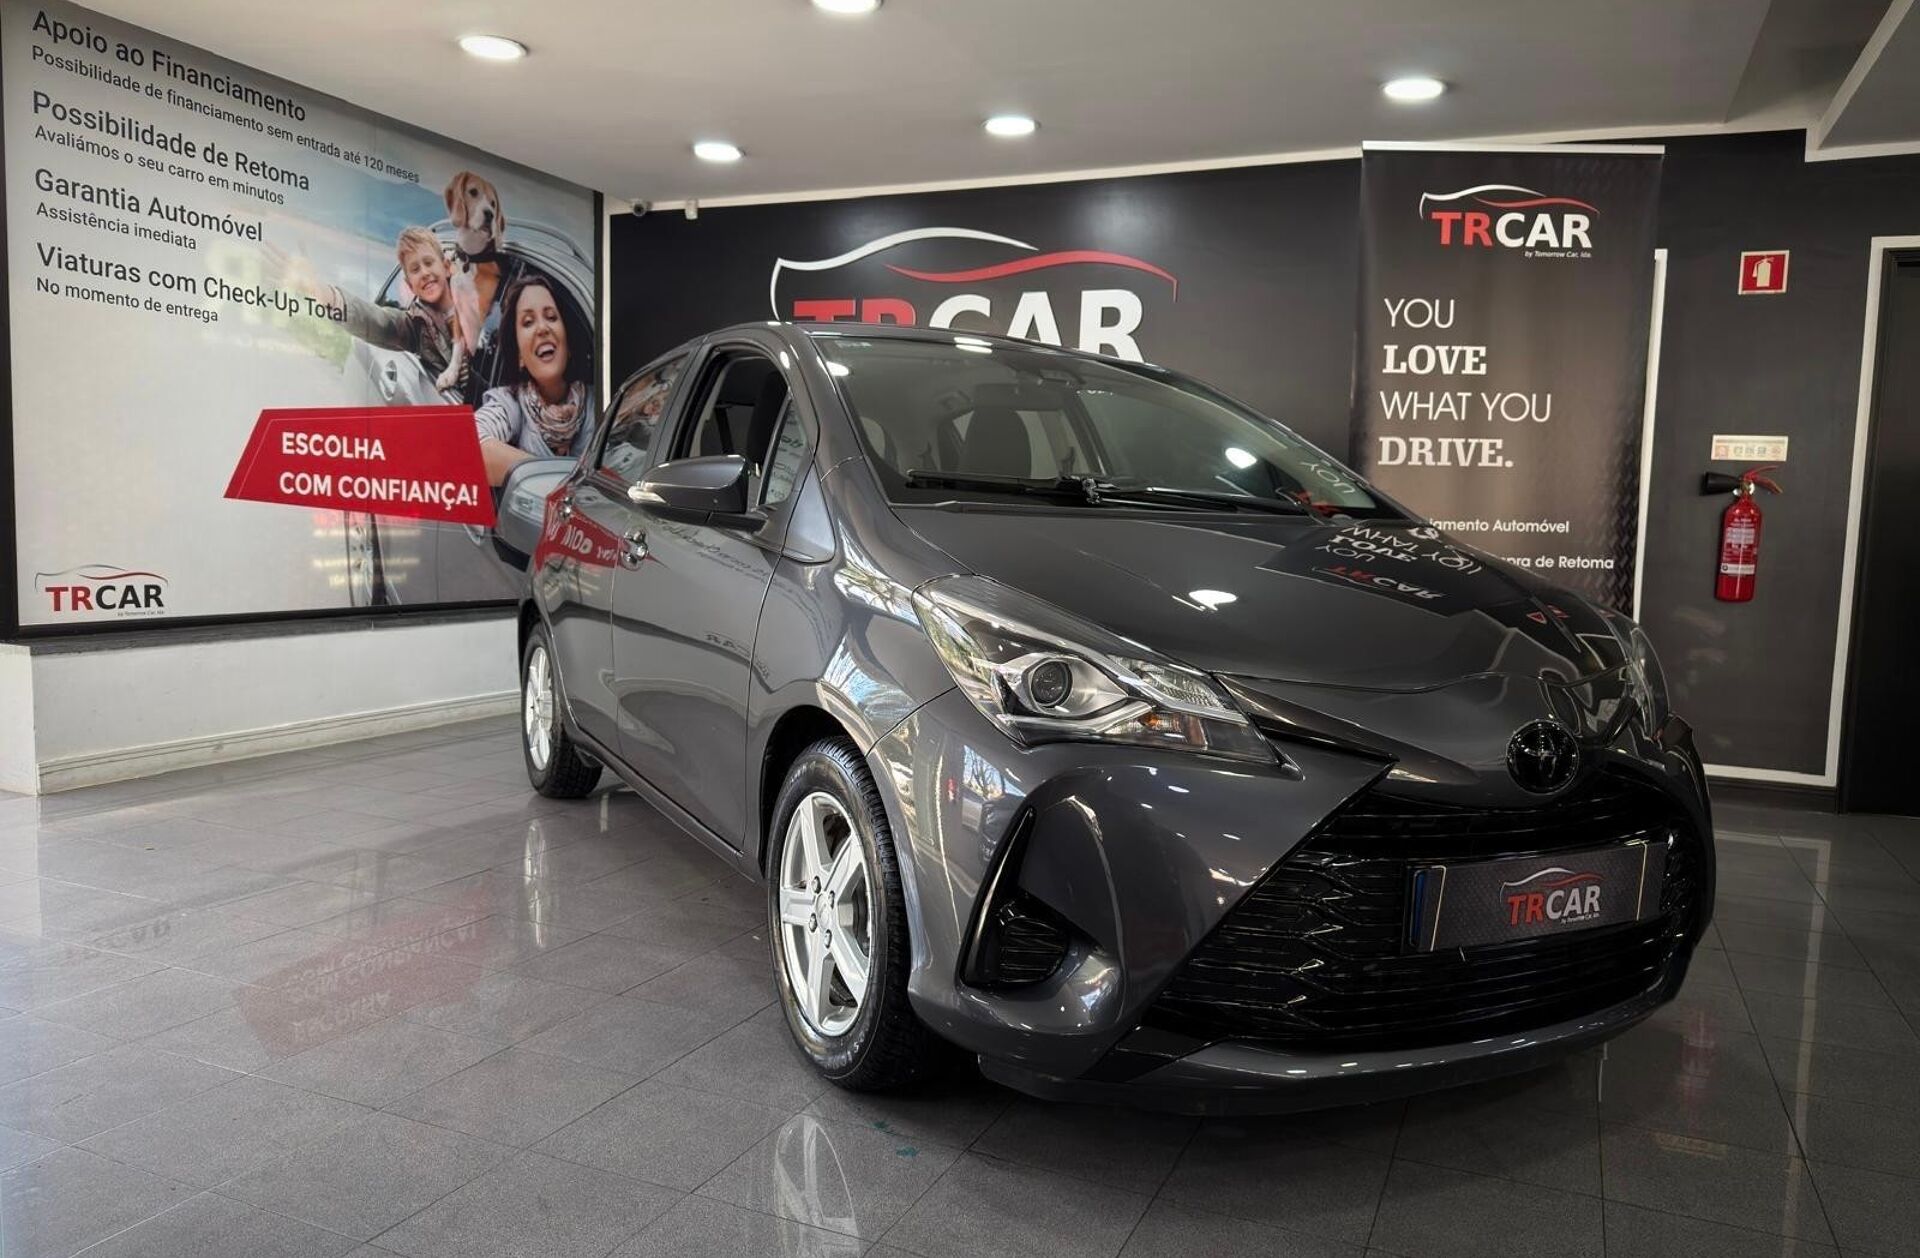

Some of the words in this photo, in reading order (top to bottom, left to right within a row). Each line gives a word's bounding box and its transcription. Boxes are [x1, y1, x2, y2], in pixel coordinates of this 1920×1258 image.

[33, 10, 107, 53] Apoio
[115, 42, 144, 66] ao
[153, 49, 306, 121] Financiamento
[32, 45, 140, 92] Possibilidade
[145, 83, 163, 99] de
[167, 90, 264, 133] financiamento
[267, 124, 293, 142] sem
[297, 134, 341, 159] entrada
[343, 148, 361, 165] até
[364, 155, 384, 172] 120
[386, 163, 420, 183] meses
[33, 91, 196, 158] Possibilidade
[203, 143, 229, 167] de
[235, 152, 310, 191] Retoma
[35, 125, 120, 161] Avaliámos
[124, 151, 134, 164] o
[138, 154, 164, 172] seu
[169, 164, 204, 183] carro
[209, 174, 229, 189] em
[233, 177, 284, 205] minutos
[35, 168, 140, 213] Garantia
[148, 197, 263, 242] Automóvel
[37, 203, 129, 235] Assistência
[134, 224, 197, 250] imediata
[1431, 211, 1592, 249] TRCAR
[37, 242, 141, 284] Viaturas
[149, 270, 196, 294] com
[204, 276, 300, 314] Check-Up
[305, 297, 348, 323] Total
[37, 278, 60, 295] No
[65, 285, 139, 309] momento
[143, 297, 162, 313] de
[166, 302, 218, 323] entrega
[1384, 298, 1455, 328] YOU
[1382, 345, 1487, 375] LOVE
[1380, 391, 1472, 420] WHAT
[1481, 392, 1551, 423] YOU
[282, 431, 386, 461] ESCOLHA
[1378, 437, 1514, 468] DRIVE.
[280, 472, 332, 497] COM
[338, 476, 478, 509] CONFIANÇA!
[1492, 519, 1569, 533] Automóvel
[1535, 555, 1554, 568] de
[1558, 556, 1614, 569] Retoma
[45, 584, 164, 612] TRCAR
[1508, 885, 1601, 926] TRCAR
